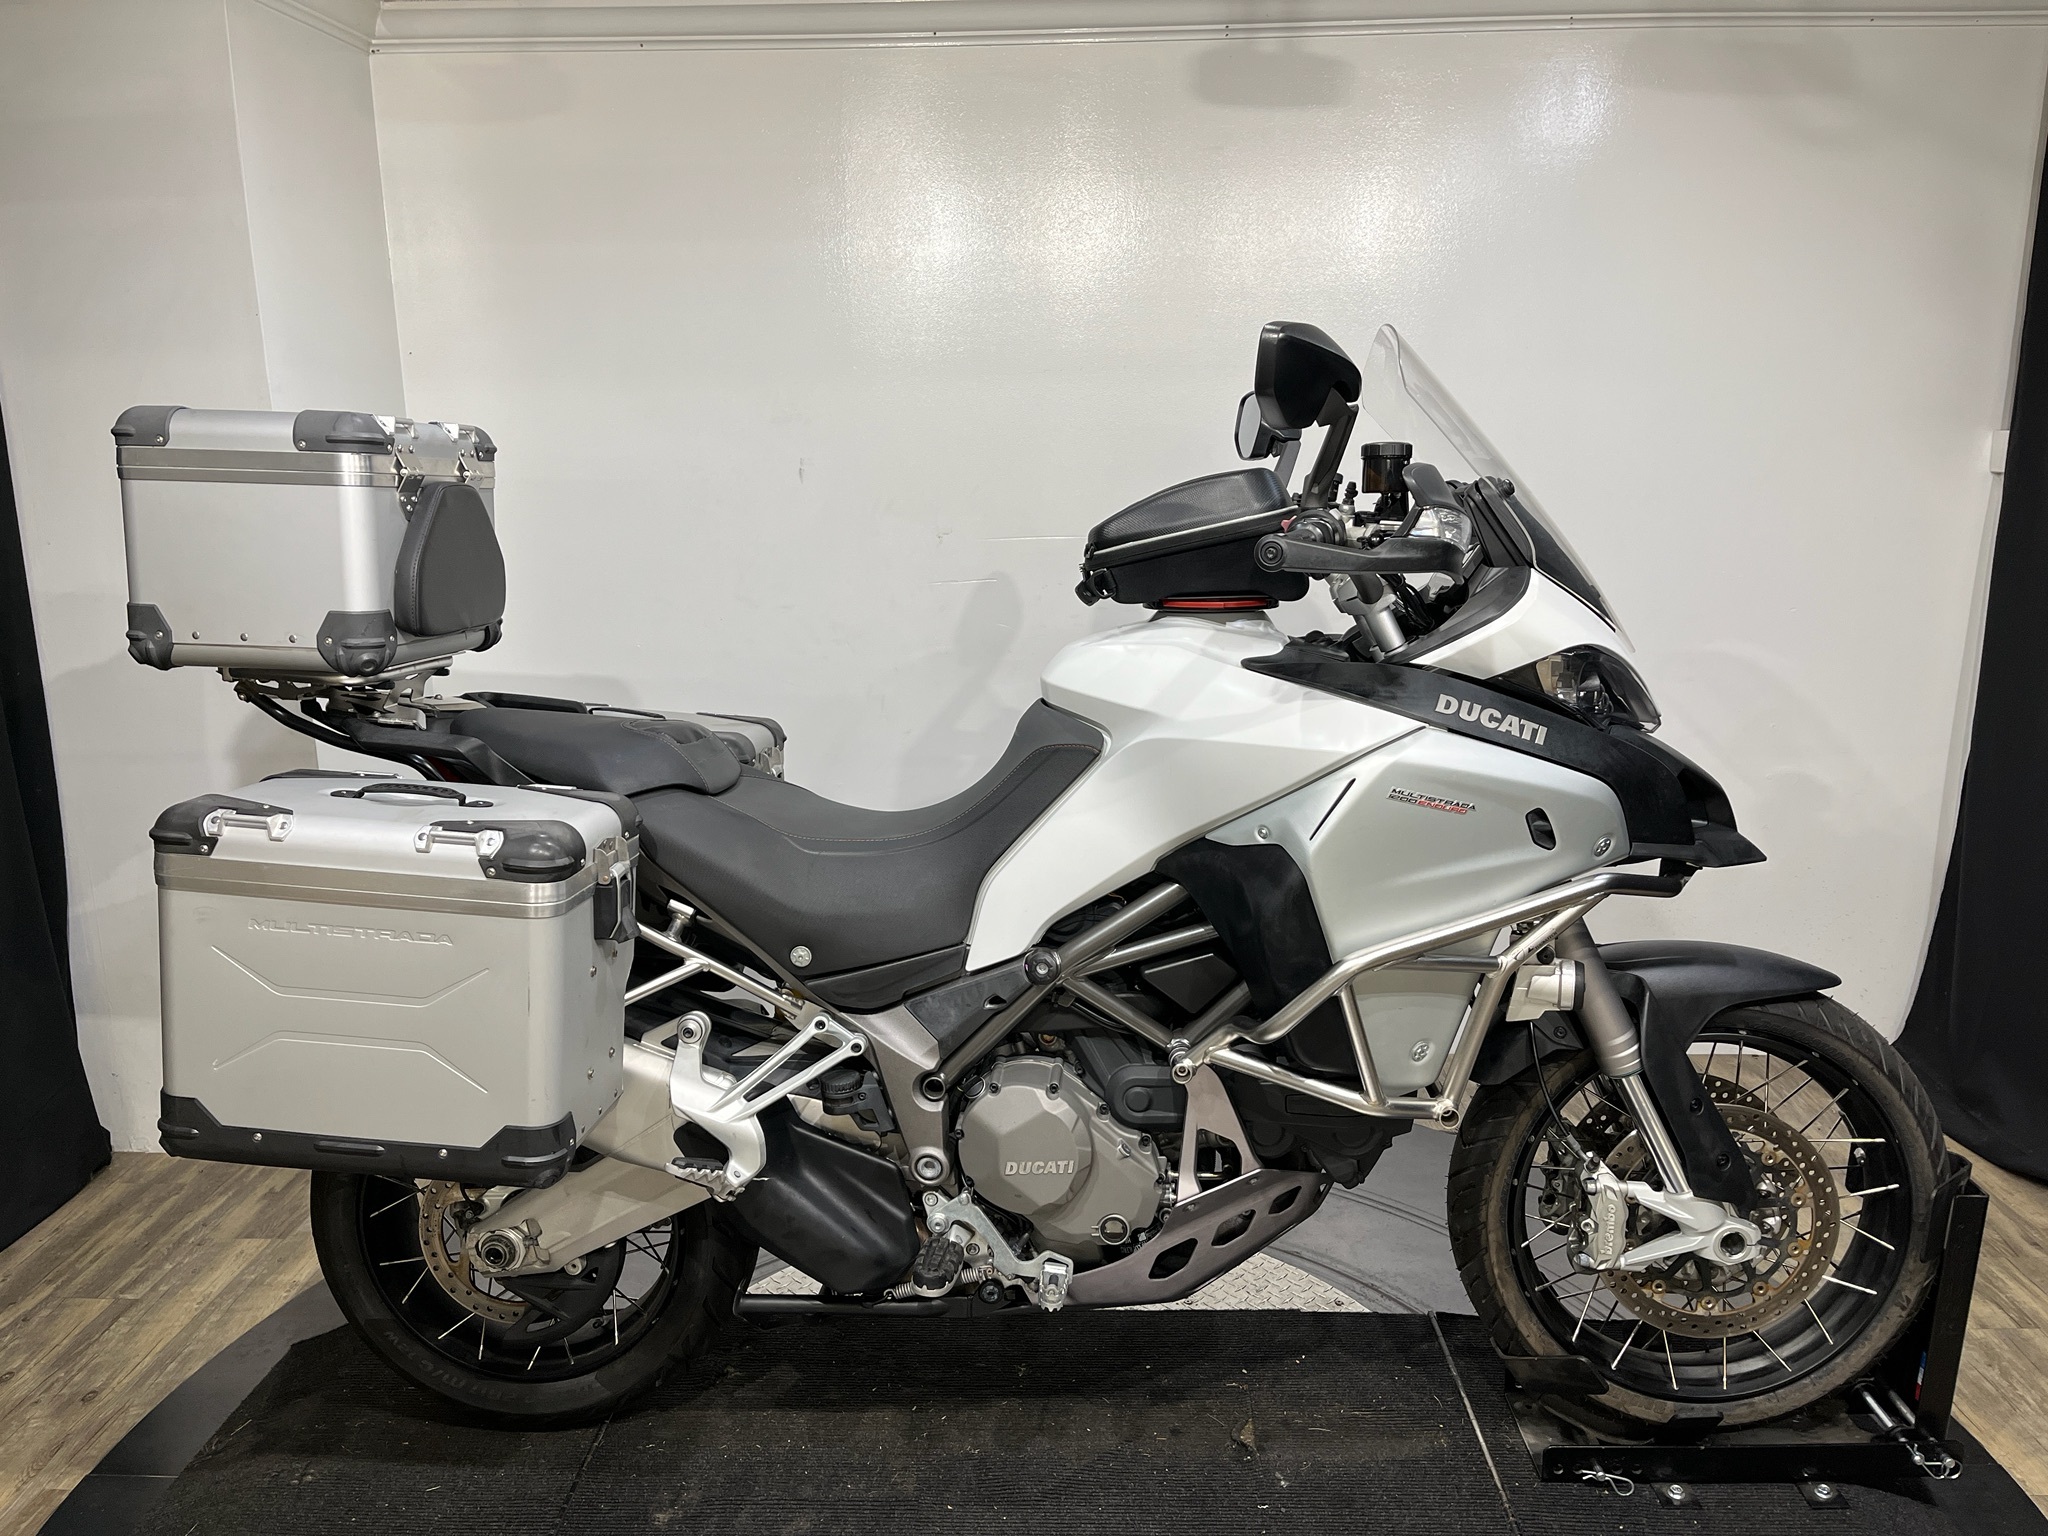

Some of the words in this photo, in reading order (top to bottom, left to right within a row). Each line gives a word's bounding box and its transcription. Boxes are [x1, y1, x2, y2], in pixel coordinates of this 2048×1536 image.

[1435, 693, 1548, 746] DUCATI
[1391, 787, 1476, 811] MULTISTRADA
[247, 918, 454, 947] MULTISTRADA
[1004, 1160, 1075, 1176] DUCATI
[1600, 1203, 1617, 1256] brembo
